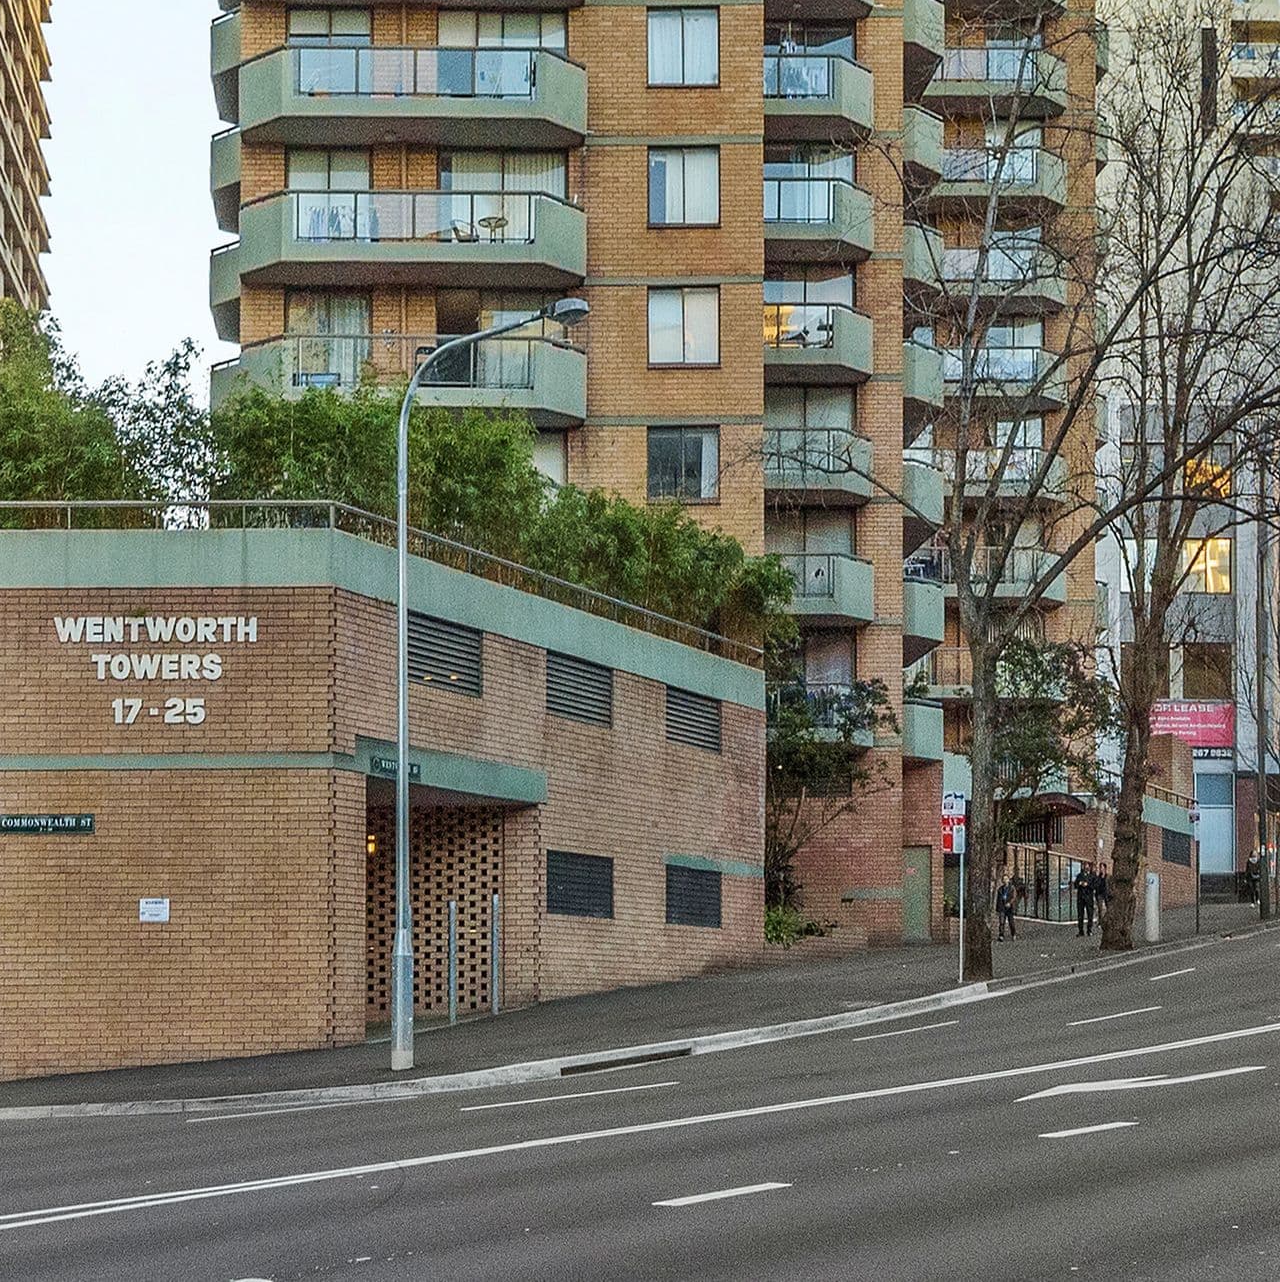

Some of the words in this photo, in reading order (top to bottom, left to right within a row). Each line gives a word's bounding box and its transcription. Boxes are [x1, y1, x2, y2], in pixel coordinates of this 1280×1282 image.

[54, 616, 258, 643] WENTWORTH
[91, 653, 222, 680] TOWERS
[112, 698, 143, 724] 17
[164, 698, 206, 724] 25
[1174, 703, 1215, 713] LEASE
[1, 818, 76, 827] COMMONWEALTH
[80, 818, 92, 827] ST
